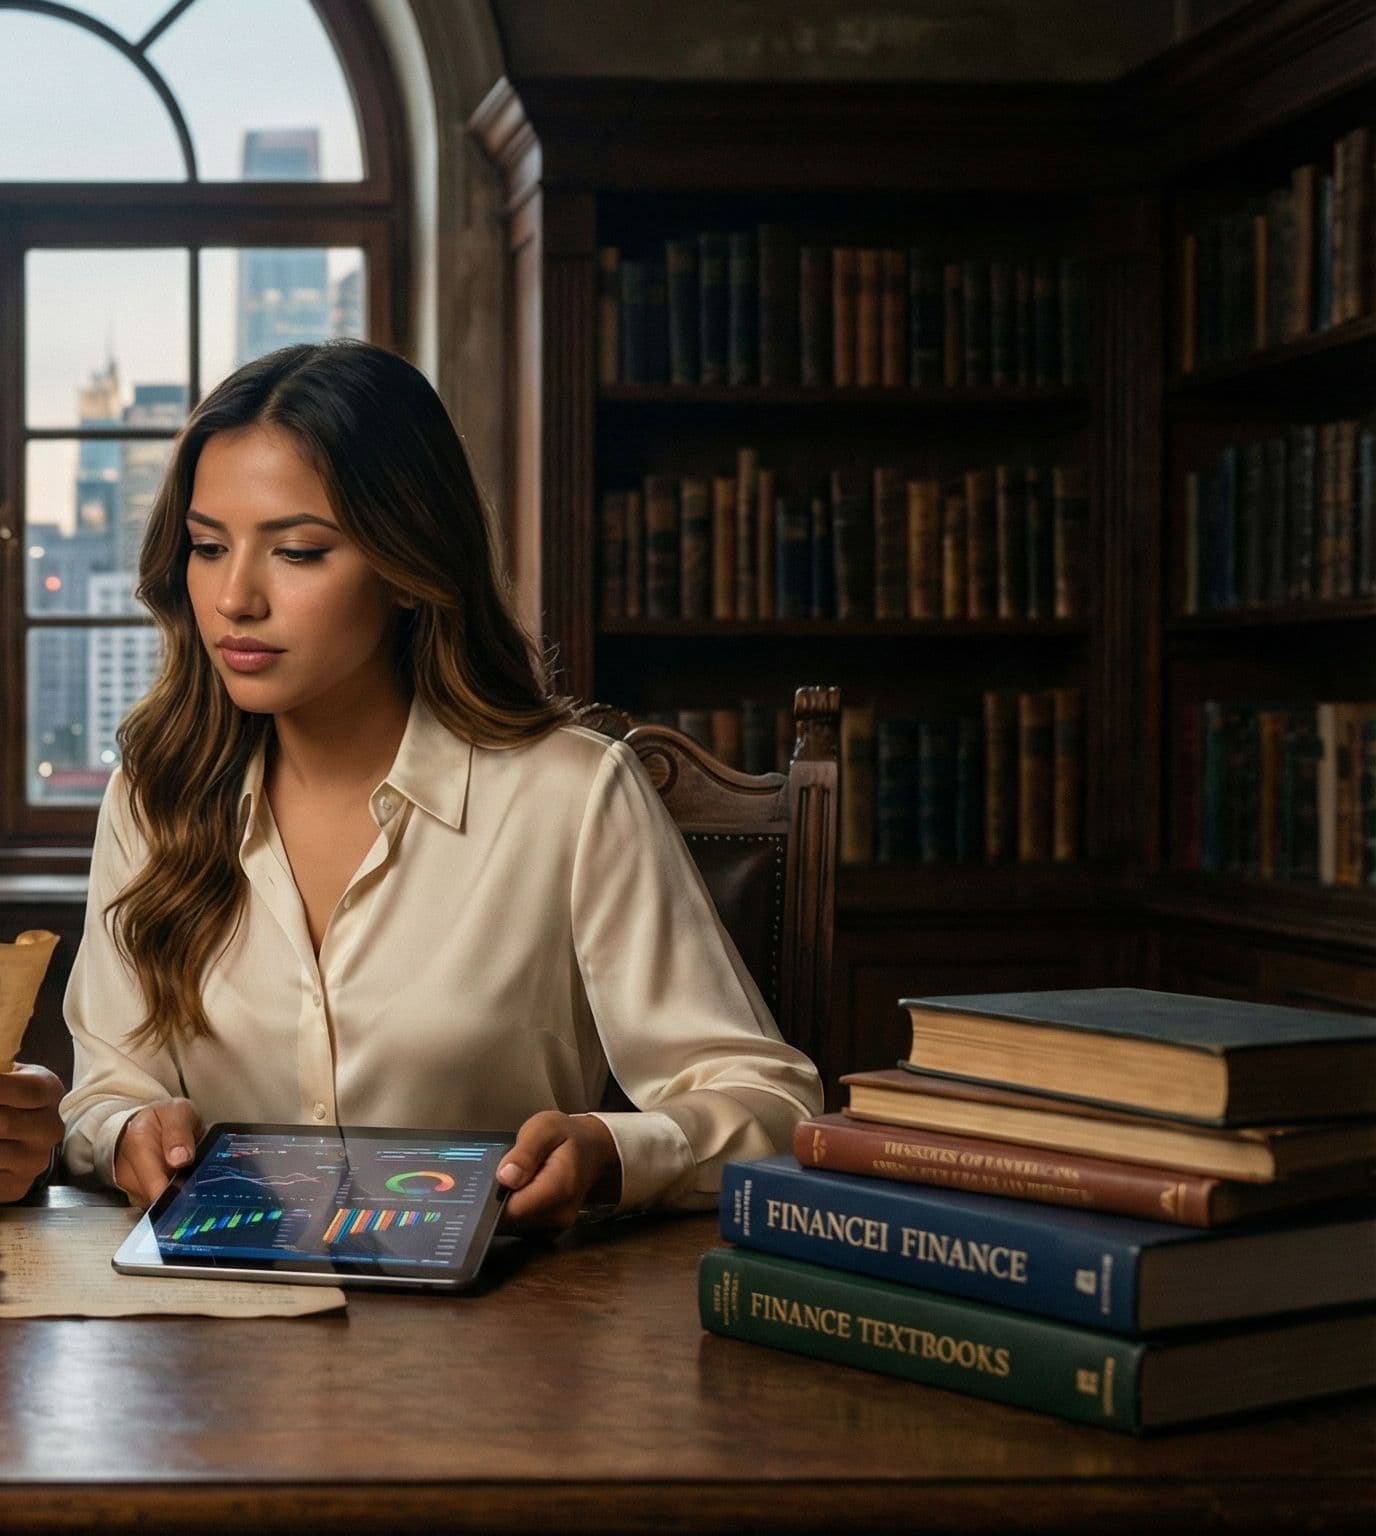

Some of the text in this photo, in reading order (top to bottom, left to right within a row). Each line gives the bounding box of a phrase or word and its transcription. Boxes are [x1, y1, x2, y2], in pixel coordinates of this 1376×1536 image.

[901, 1226, 1029, 1283] FINANCE
[750, 1291, 852, 1339] FINANCE
[856, 1316, 1011, 1378] TEXTBOOKS
